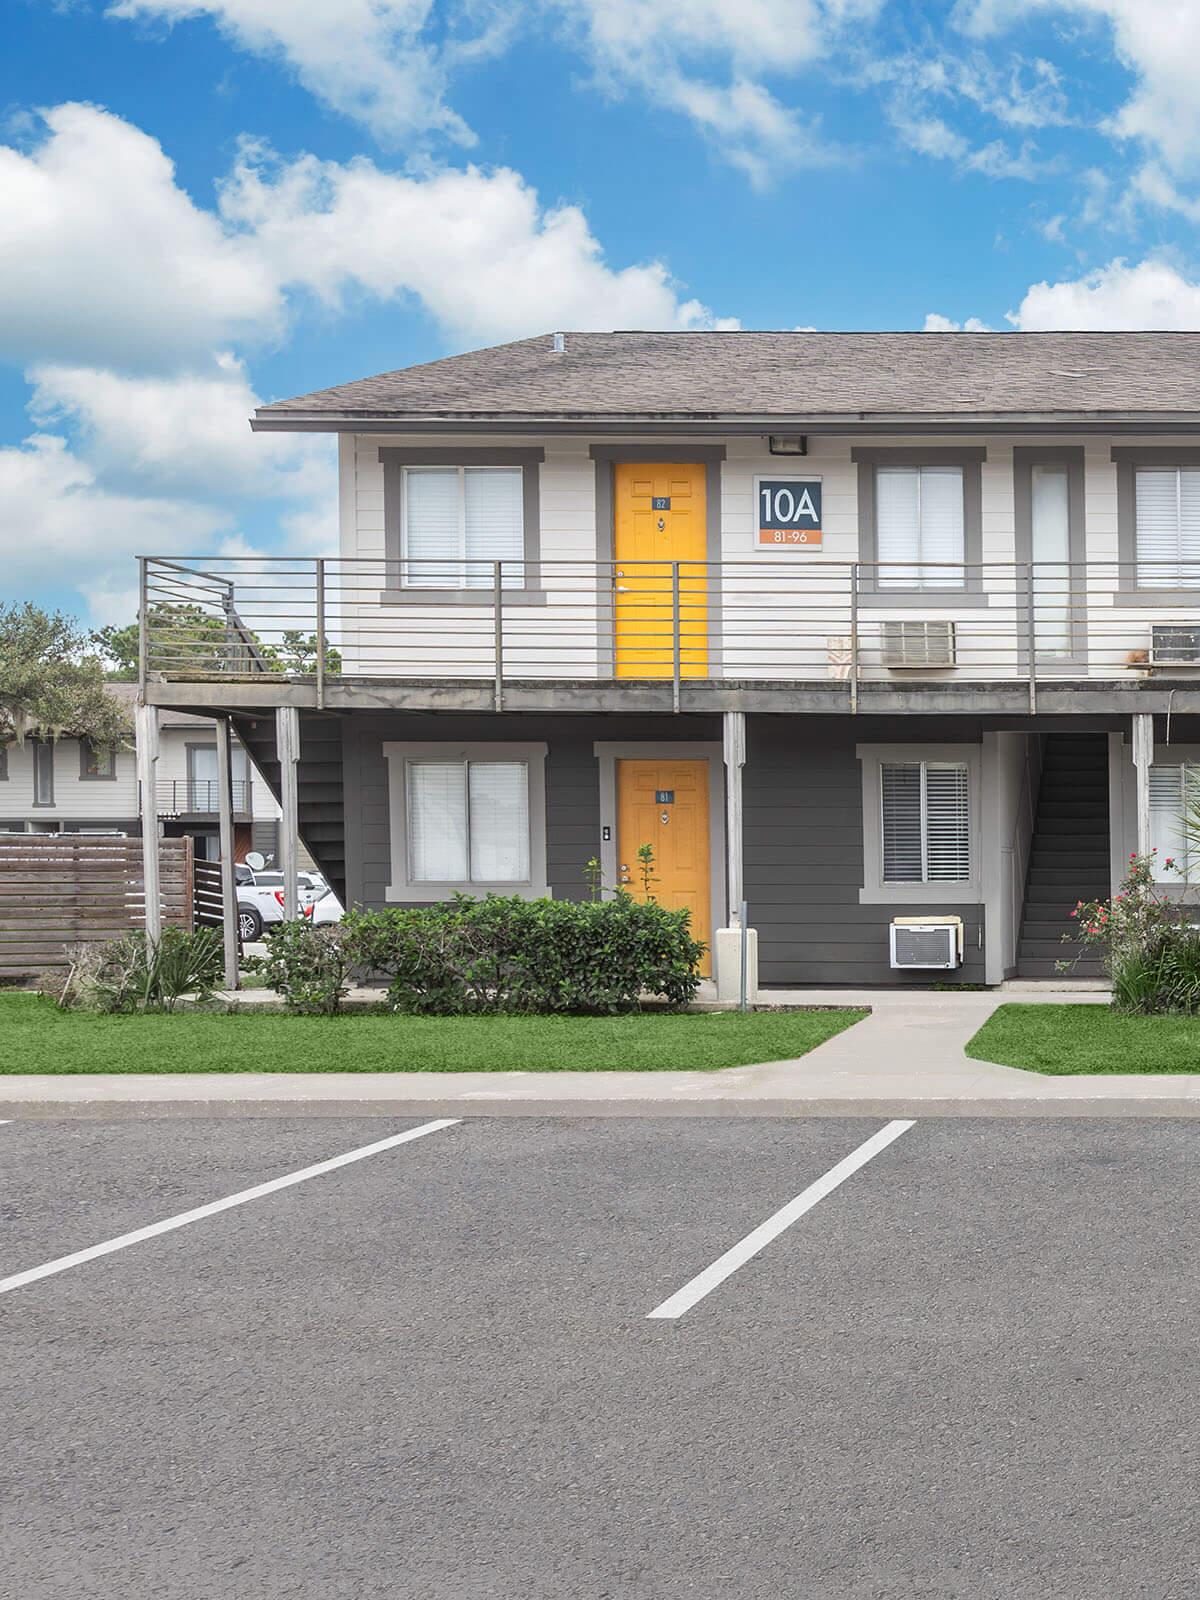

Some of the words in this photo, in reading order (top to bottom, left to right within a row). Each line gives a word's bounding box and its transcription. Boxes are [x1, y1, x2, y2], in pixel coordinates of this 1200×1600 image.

[656, 498, 666, 509] 82
[761, 488, 819, 522] 10A
[774, 531, 807, 543] 81-96
